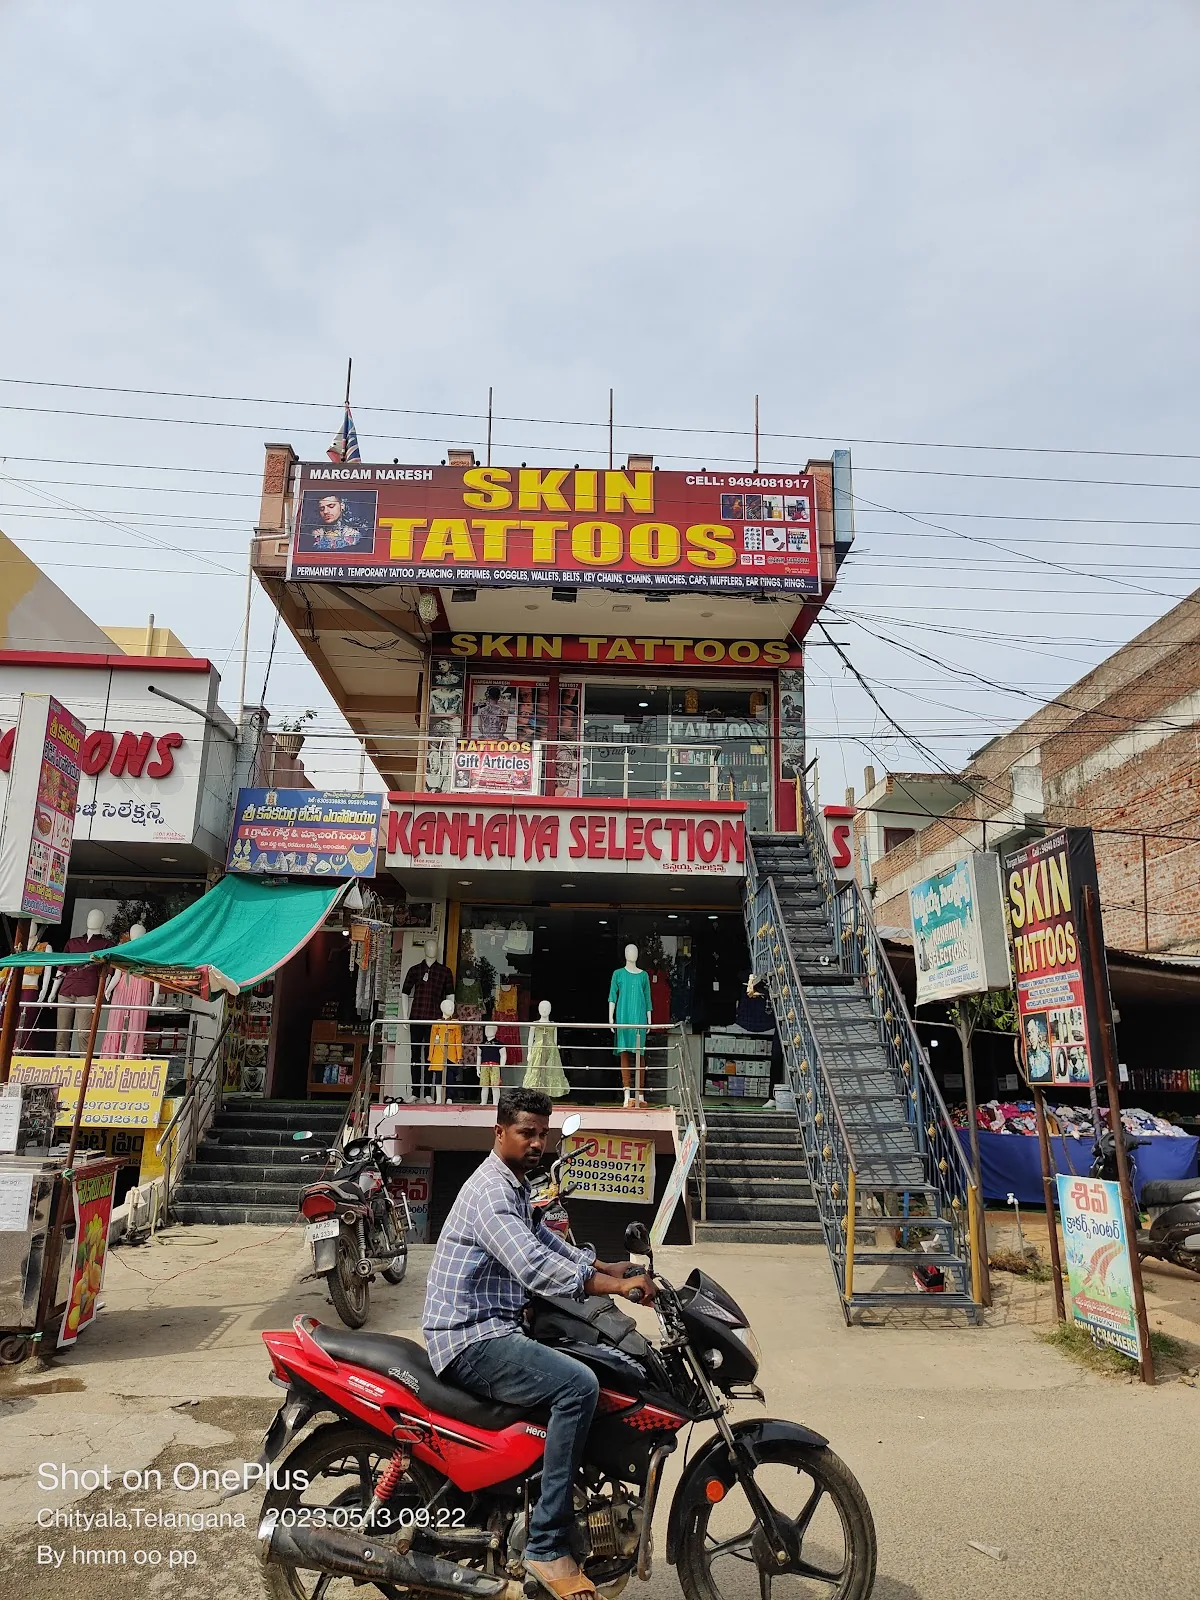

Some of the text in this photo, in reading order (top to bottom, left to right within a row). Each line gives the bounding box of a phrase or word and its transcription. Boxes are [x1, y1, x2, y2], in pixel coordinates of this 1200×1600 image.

[309, 469, 433, 481] MARGAM NARESH
[686, 475, 809, 489] CELL: 9494081917
[463, 467, 655, 515] SKIN
[378, 517, 738, 569] TATTOOS
[297, 566, 338, 577] PERMANENT
[338, 567, 344, 577] &
[347, 567, 388, 577] TEMPORARY
[389, 568, 415, 578] TATTOO
[456, 569, 492, 580] PERFUMES,
[494, 570, 530, 581] GOGGLES,
[530, 571, 561, 582] WALLETS,
[562, 572, 582, 583] BELTS,
[583, 572, 596, 582] KEY
[597, 572, 624, 584] CHAINS,
[626, 574, 653, 585] CHAINS,
[655, 574, 688, 586] WATCHES,
[689, 575, 709, 586] CAPS,
[710, 576, 745, 587] MUFFLERS,
[746, 577, 759, 586] EAR
[450, 634, 792, 665] SKIN TATTOOS
[668, 721, 768, 738] TATTOOS
[457, 740, 531, 754] TATTOOS
[456, 754, 531, 770] Gift Articles
[387, 809, 560, 863] KANHAIYA
[568, 815, 745, 864] SELECTION
[1008, 850, 1072, 929] SKIN
[1014, 920, 1078, 974] TATTOOS
[69, 1113, 149, 1124] 780512648
[571, 1136, 649, 1162] TO-LET
[570, 1158, 647, 1173] 9948990717
[568, 1169, 646, 1184] 9900296474
[1070, 1182, 1108, 1214] శివ
[1096, 1326, 1139, 1354] CRACKERS
[525, 1425, 547, 1439] Hero
